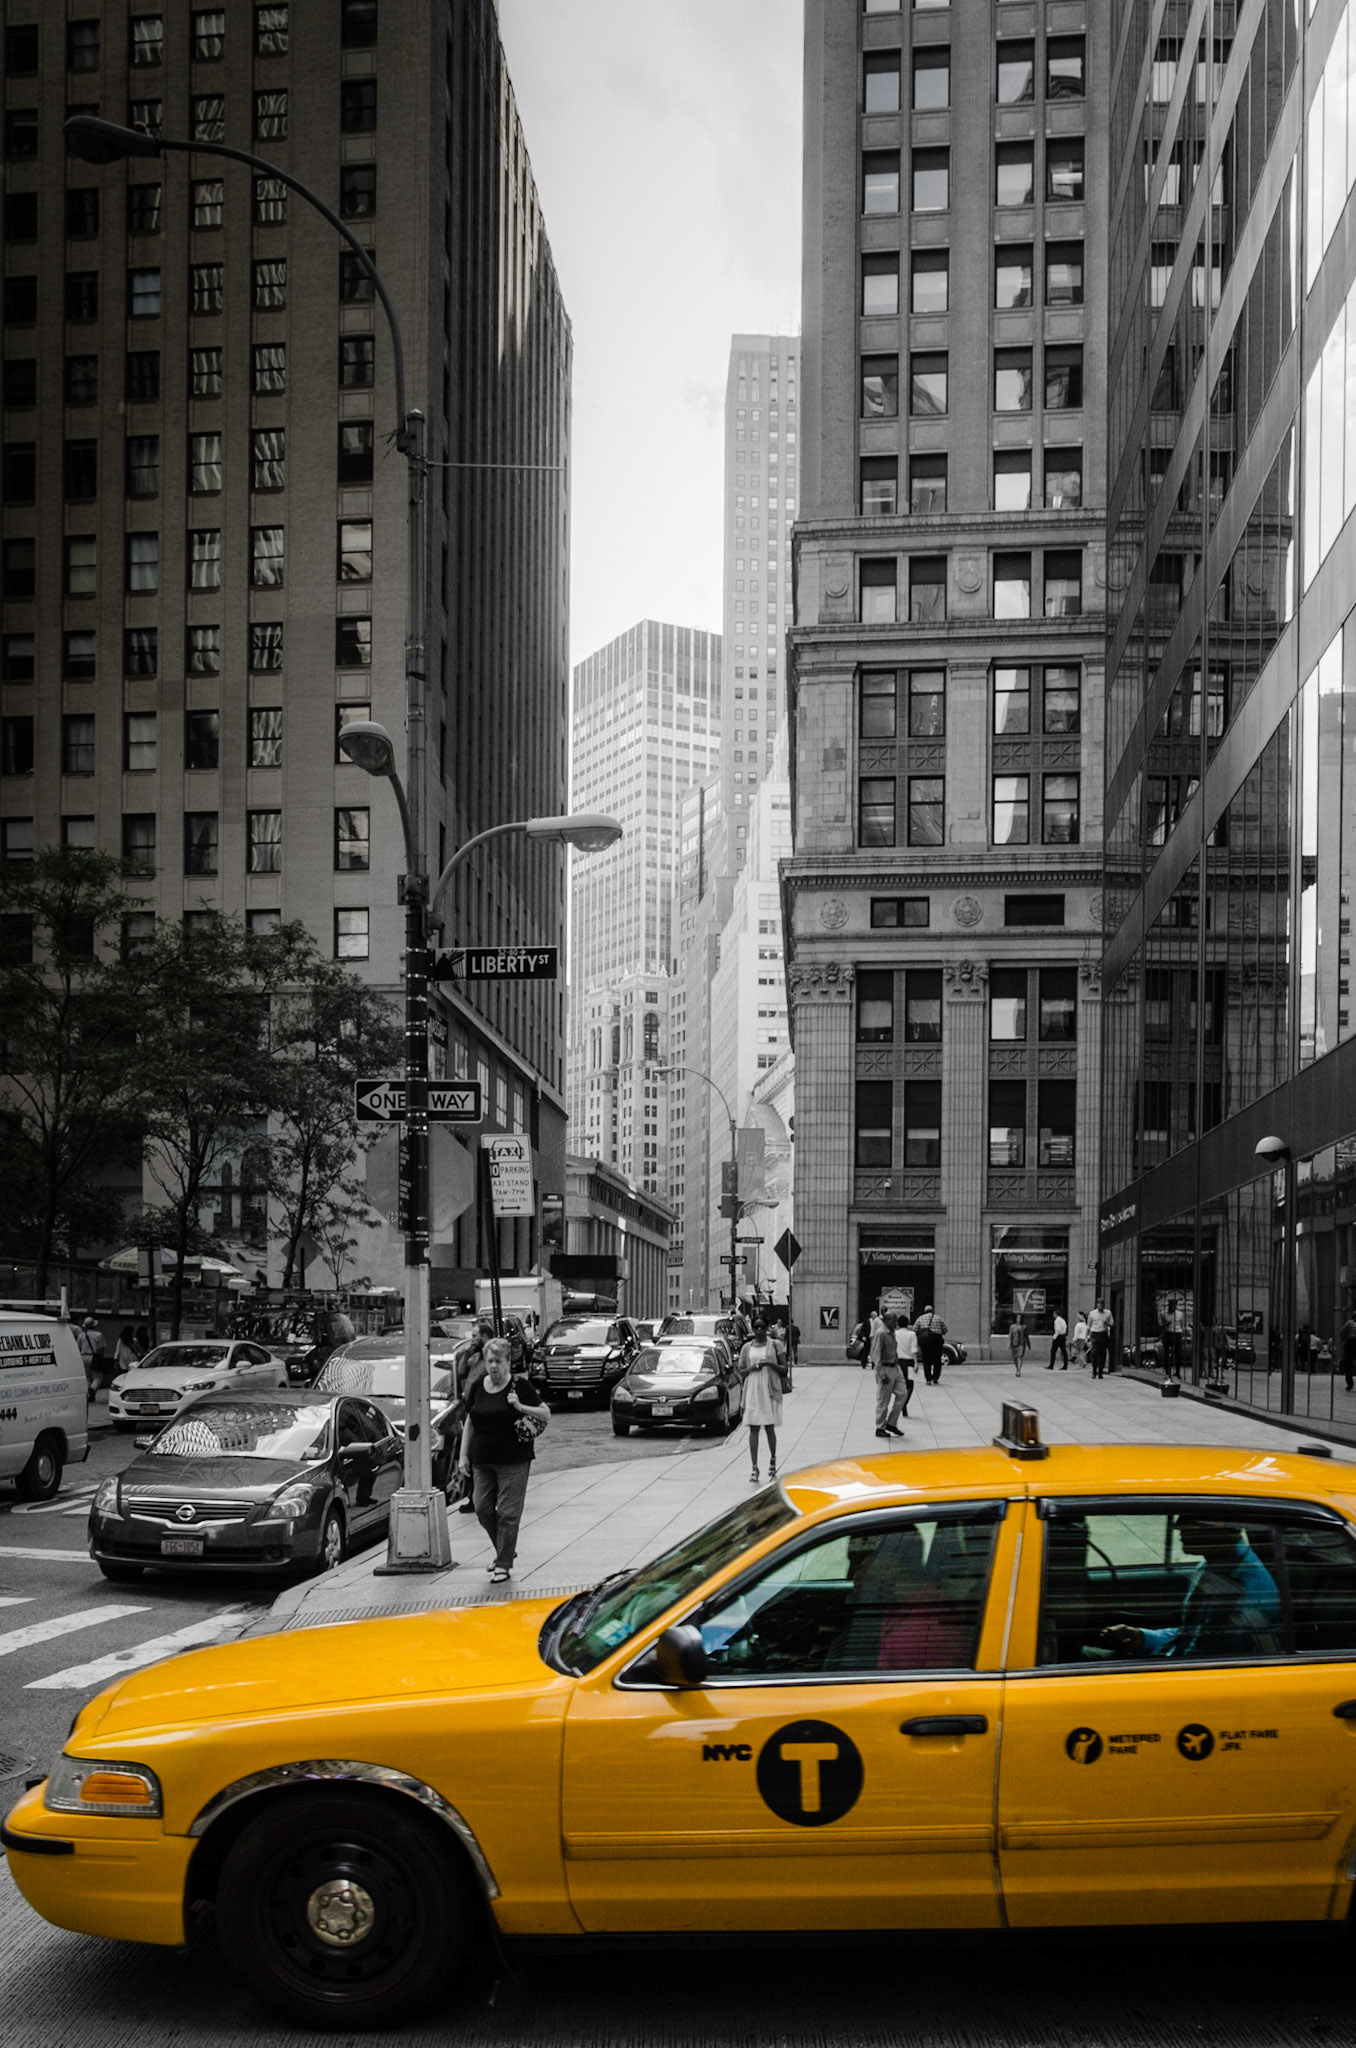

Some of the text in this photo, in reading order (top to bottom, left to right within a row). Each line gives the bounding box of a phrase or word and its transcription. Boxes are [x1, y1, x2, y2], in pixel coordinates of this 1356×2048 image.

[471, 954, 549, 973] LIBERTY ST
[370, 1093, 469, 1109] ONE WAY
[500, 1166, 530, 1174] PARKING
[872, 1251, 892, 1263] Valley
[892, 1253, 918, 1261] National
[918, 1253, 935, 1261] Bank
[1003, 1253, 1068, 1264] Valley National Bank
[34, 1333, 54, 1349] CORP.
[1108, 1733, 1161, 1744] METERED
[1219, 1729, 1279, 1740] FLAT FARE
[1109, 1745, 1138, 1754] FARE
[1221, 1741, 1242, 1751] JFK
[702, 1742, 839, 1813] NYC T
